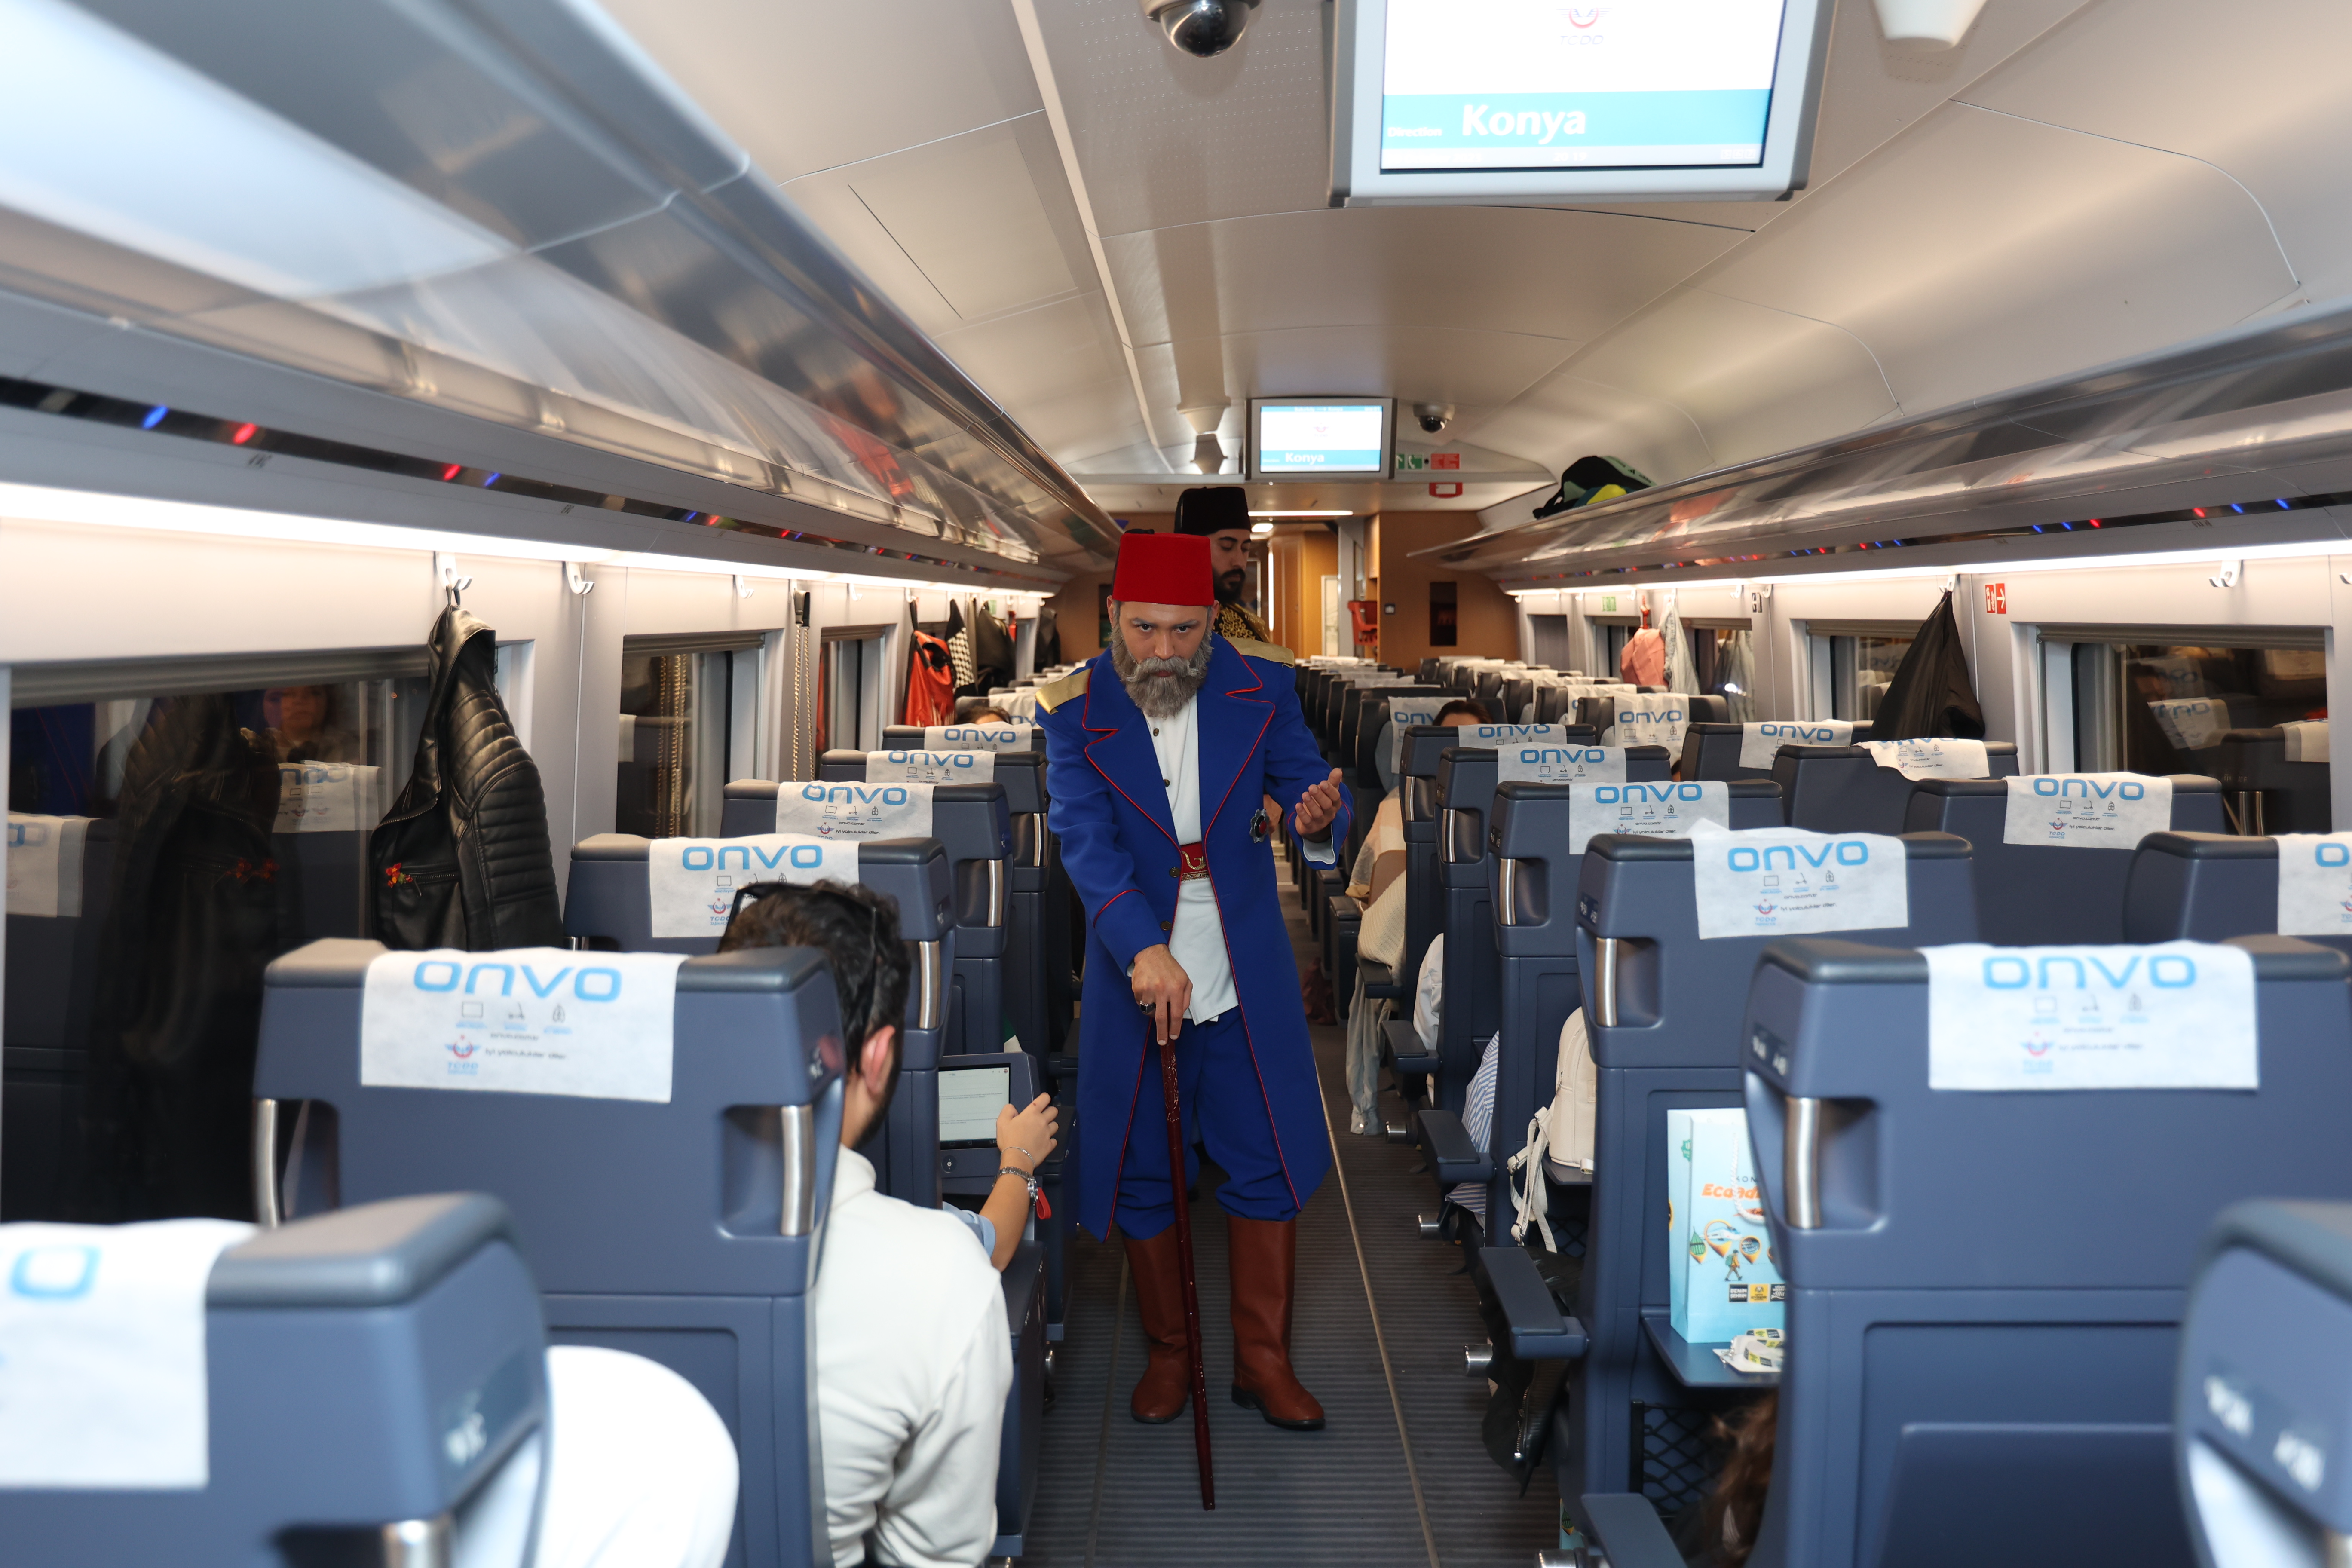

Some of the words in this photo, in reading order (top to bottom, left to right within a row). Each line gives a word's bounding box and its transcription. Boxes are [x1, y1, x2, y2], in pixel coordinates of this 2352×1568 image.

[1387, 126, 1442, 137] Direction
[1462, 104, 1586, 144] Konya
[1285, 453, 1324, 465] Konya
[1620, 710, 1682, 724] onvo
[944, 729, 1016, 743] onvo
[1479, 724, 1550, 738] onvo
[1761, 724, 1834, 741] onvo
[888, 751, 974, 768] onvo
[1520, 749, 1605, 764] onvo
[802, 784, 907, 805] onvo
[1595, 784, 1702, 804] onvo
[2033, 777, 2144, 801] onvo
[682, 845, 823, 870] onvo
[1727, 841, 1868, 872] onvo
[414, 961, 622, 1002] onvo
[1983, 955, 2196, 989] onvo
